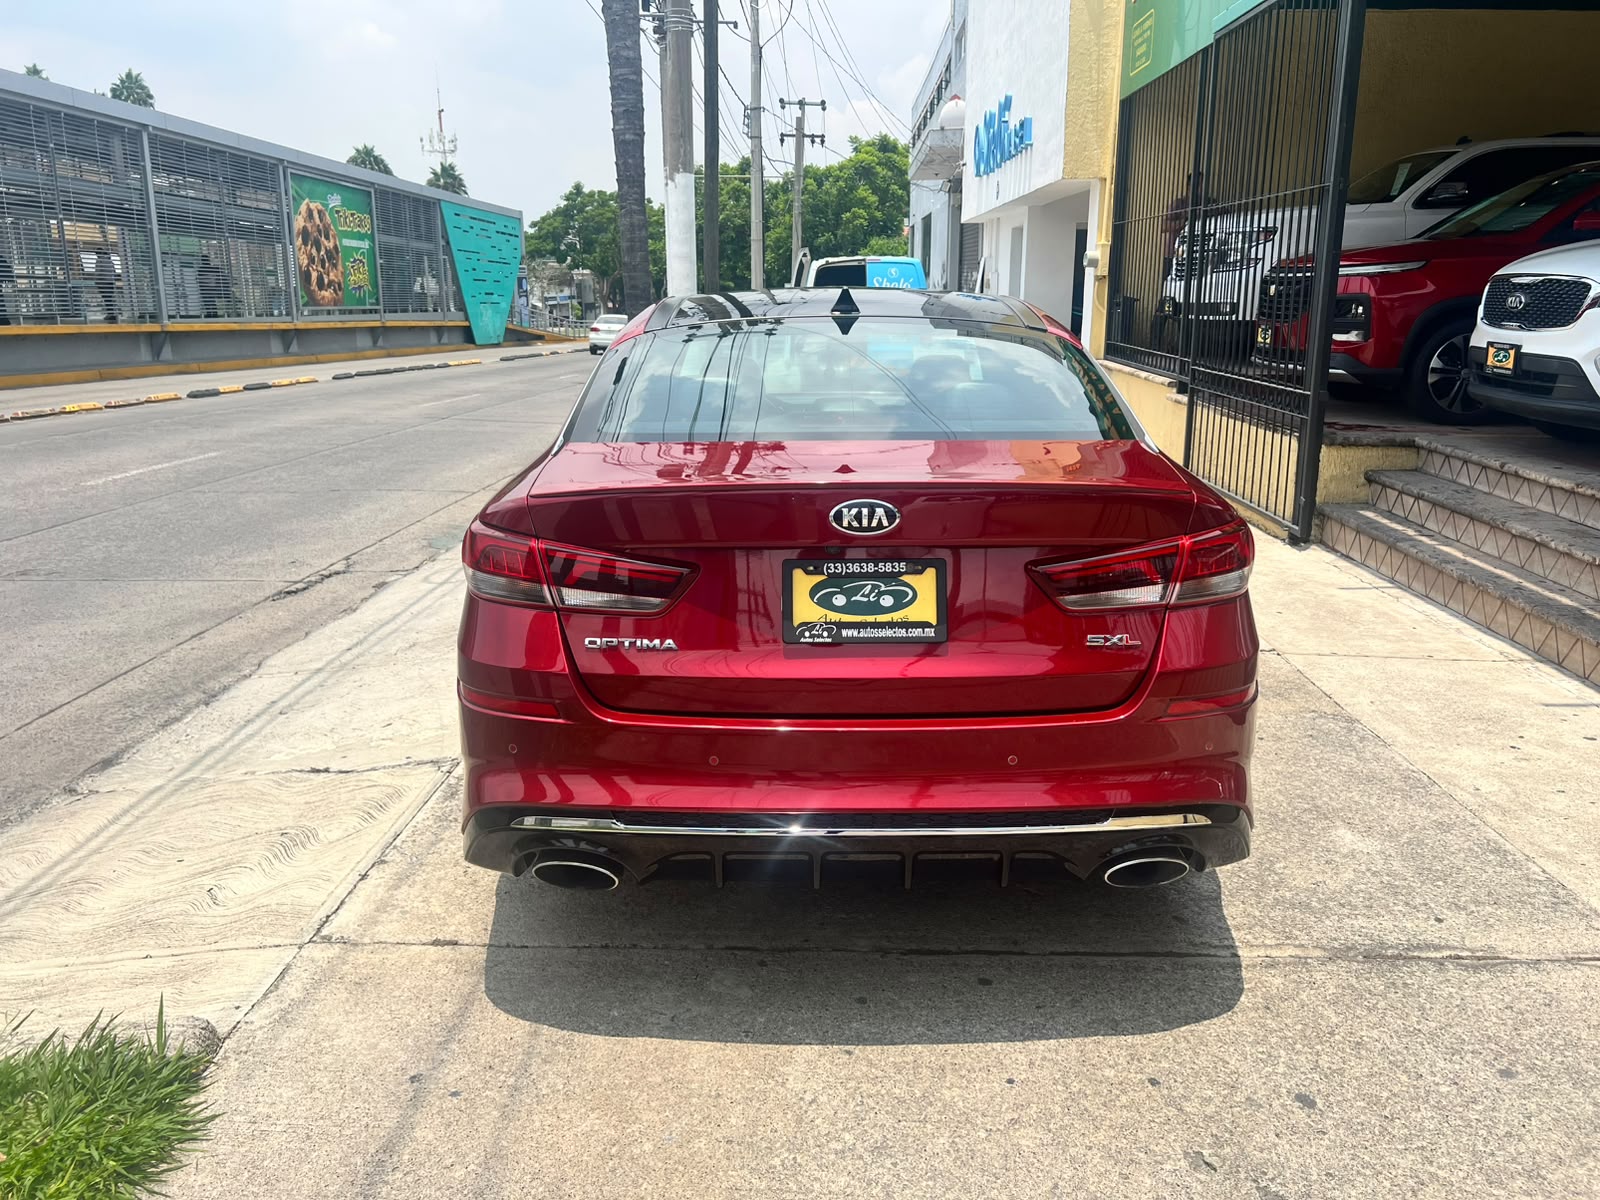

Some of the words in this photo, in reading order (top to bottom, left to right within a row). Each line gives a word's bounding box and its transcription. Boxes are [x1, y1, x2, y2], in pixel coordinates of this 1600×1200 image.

[841, 507, 889, 527] KIA
[823, 562, 907, 575] (33)3638-5835
[841, 626, 935, 638] www.autosselectos.com.mx
[584, 637, 679, 650] OPTIMA
[1085, 634, 1142, 646] SXL
